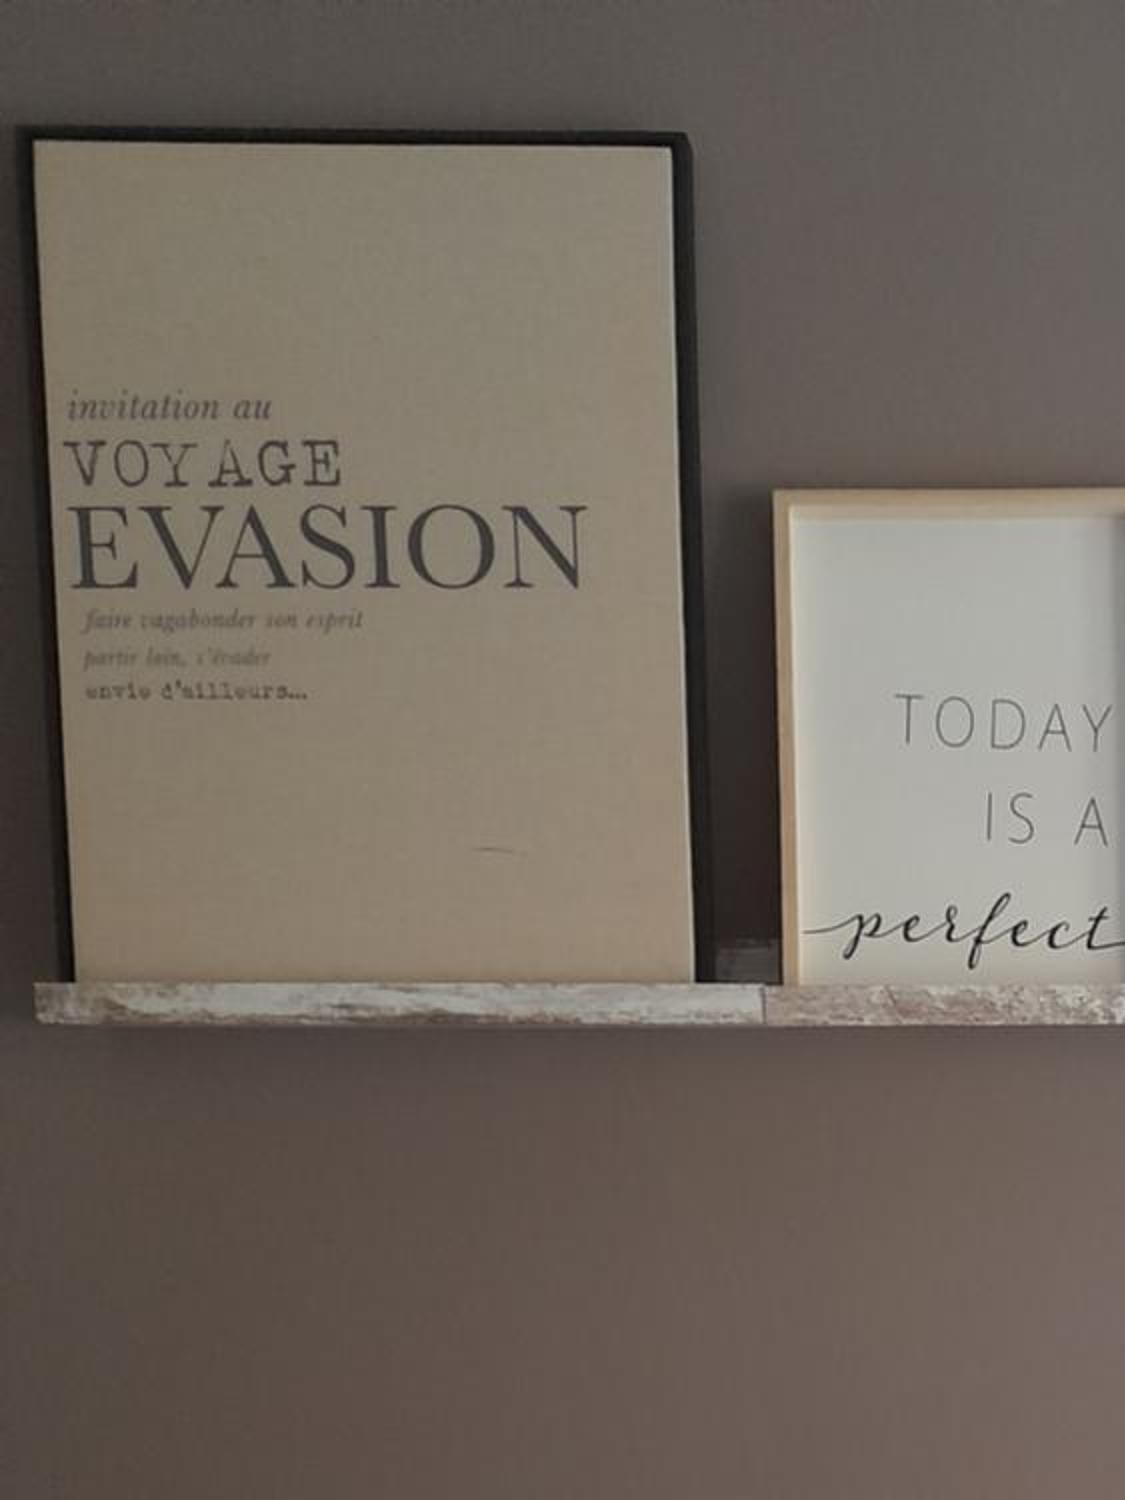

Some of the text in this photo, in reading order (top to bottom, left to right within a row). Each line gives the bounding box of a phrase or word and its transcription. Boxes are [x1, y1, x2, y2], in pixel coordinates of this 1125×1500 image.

[67, 388, 272, 420] invitation au
[63, 438, 341, 488] VOYAGE
[67, 504, 588, 590] EVASION
[80, 608, 364, 635] faire vagabonder son esprit
[83, 650, 137, 672] partir
[85, 681, 151, 700] envie
[894, 693, 1114, 754] TODAY
[985, 791, 1109, 847] IS A
